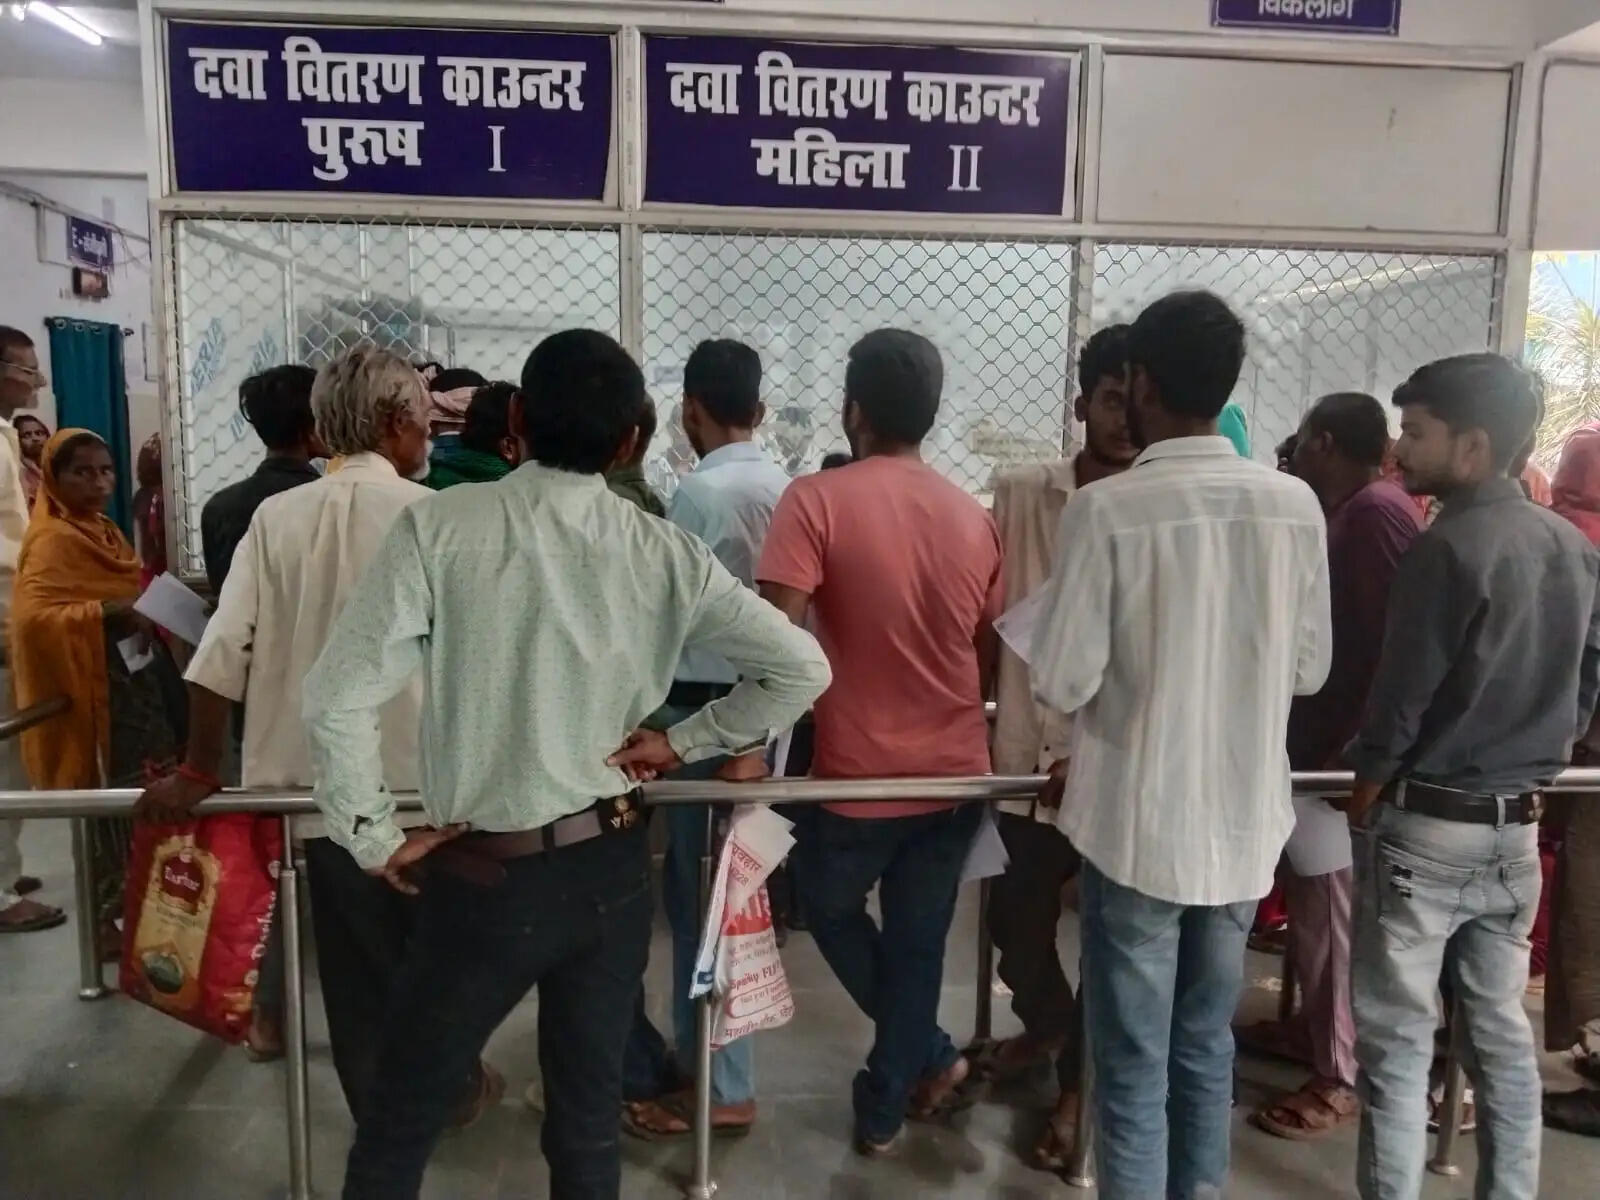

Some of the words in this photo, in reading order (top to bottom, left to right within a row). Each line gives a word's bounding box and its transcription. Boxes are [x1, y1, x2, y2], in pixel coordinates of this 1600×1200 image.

[188, 47, 269, 99] दवा
[281, 36, 425, 105] वितरण
[437, 56, 587, 111] काउन्टर
[666, 62, 743, 115] दवा
[754, 51, 892, 120] वितरण
[903, 71, 1045, 127] काउन्टर
[487, 125, 506, 172] I
[750, 127, 911, 189] महिला
[947, 145, 983, 192] II
